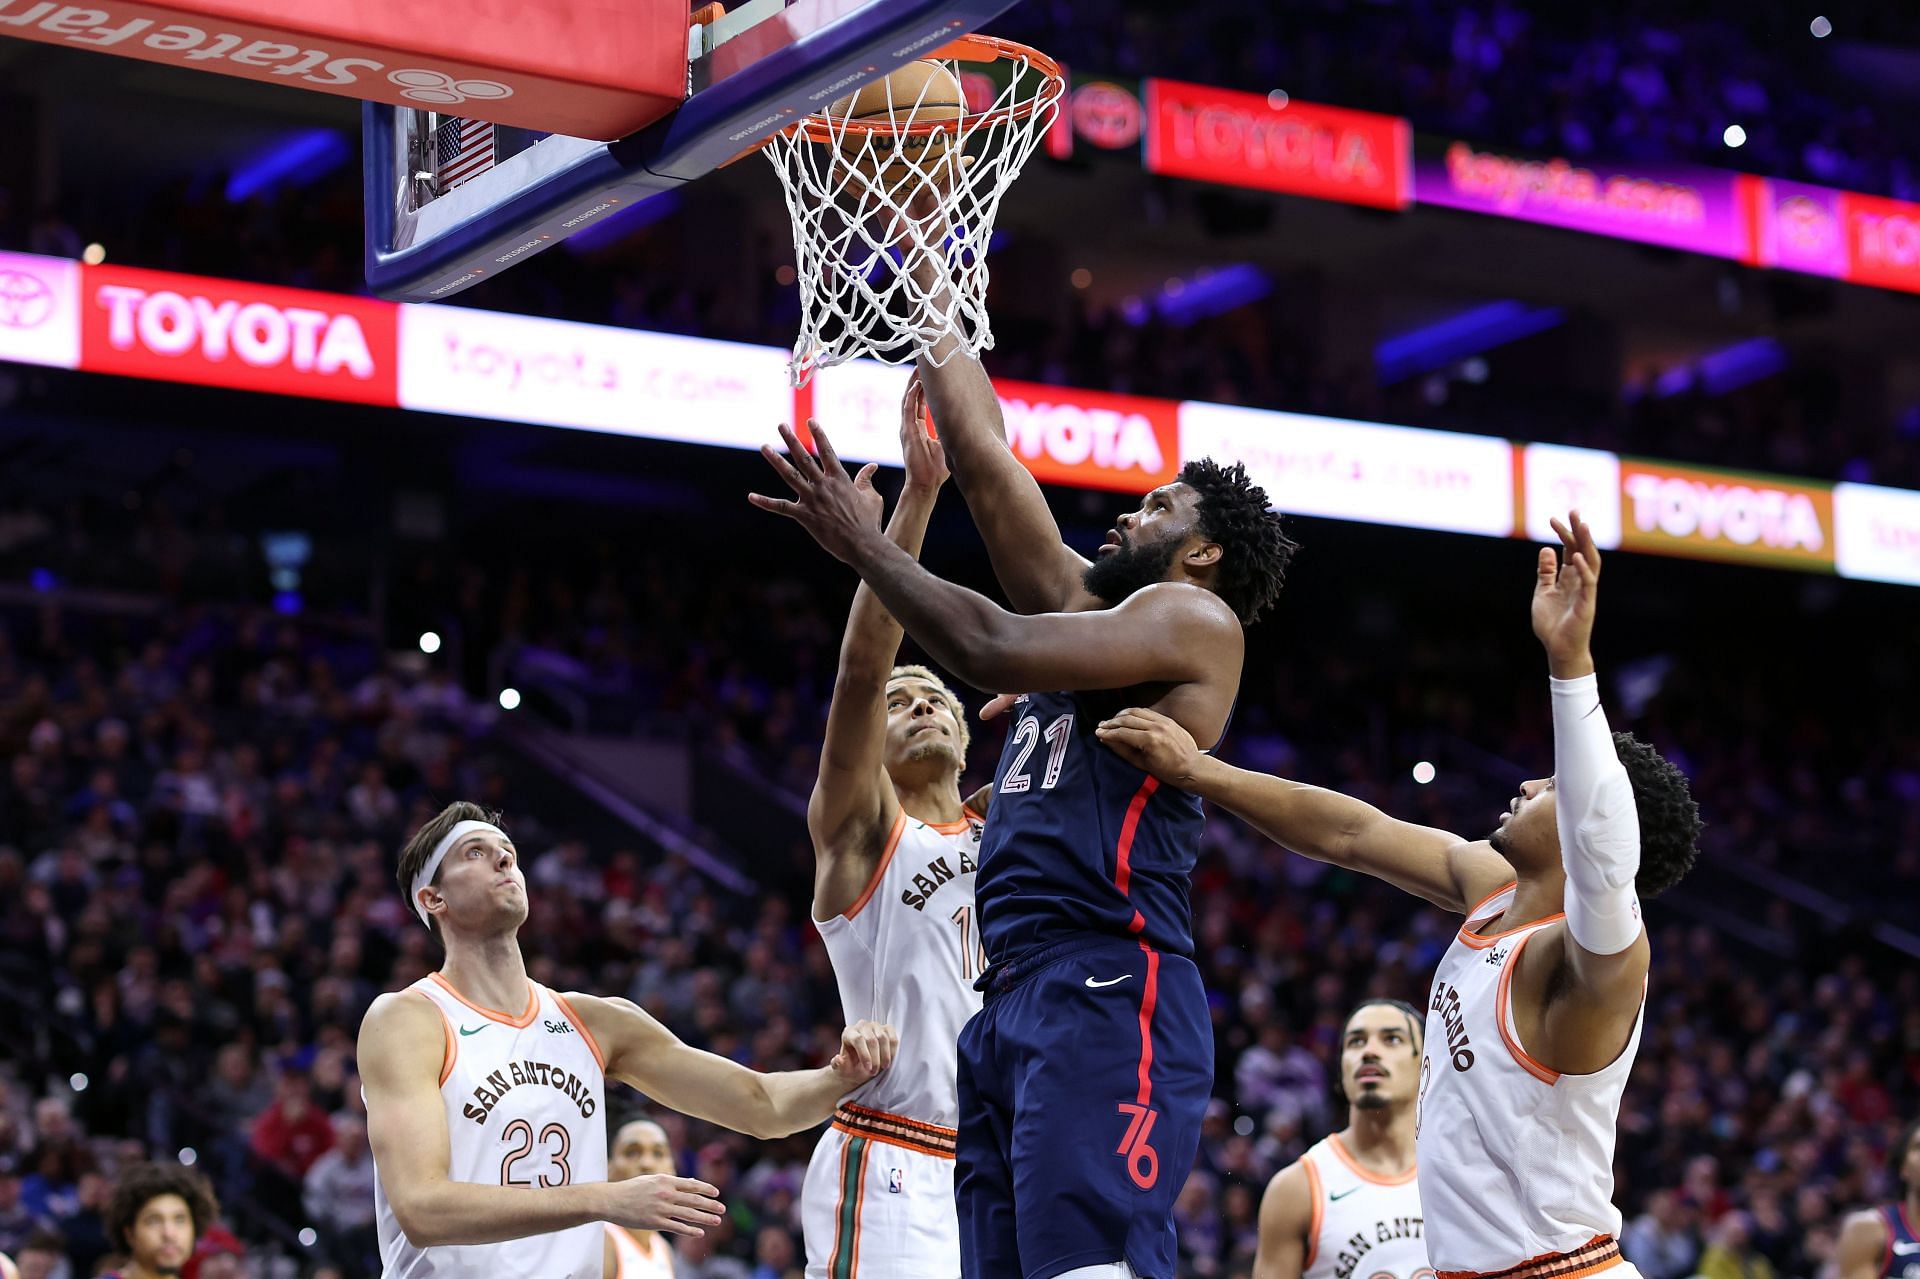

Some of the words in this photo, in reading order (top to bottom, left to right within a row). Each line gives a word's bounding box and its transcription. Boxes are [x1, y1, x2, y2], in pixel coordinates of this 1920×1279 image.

[0, 0, 155, 46] Far
[1161, 101, 1386, 189] TOYOTA
[96, 284, 375, 380] TOYOTA
[1623, 473, 1825, 552] TOYOTA
[999, 713, 1074, 794] 21
[902, 856, 955, 911] SAN
[543, 1020, 574, 1034] Self.
[463, 1069, 512, 1126] SAN
[508, 1060, 596, 1119] ANTONIO
[500, 1118, 571, 1188] 23
[1116, 1103, 1159, 1190] 76
